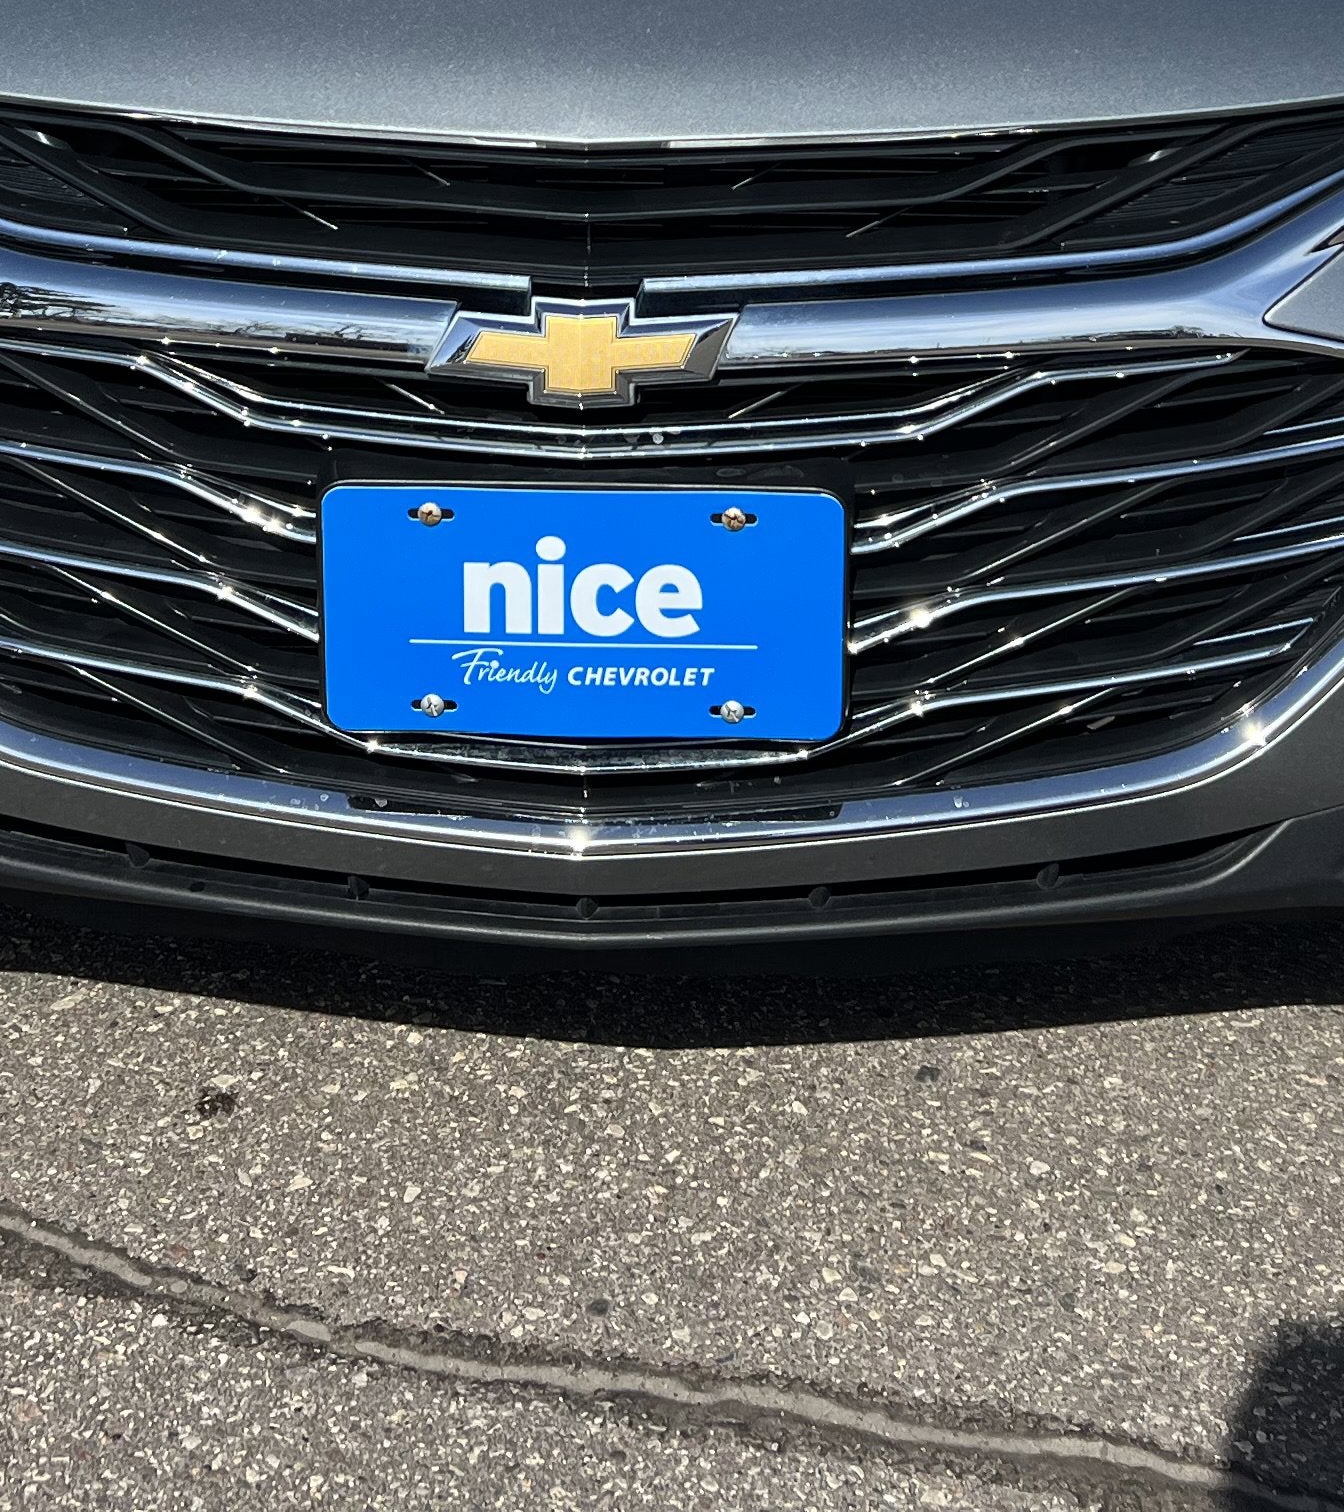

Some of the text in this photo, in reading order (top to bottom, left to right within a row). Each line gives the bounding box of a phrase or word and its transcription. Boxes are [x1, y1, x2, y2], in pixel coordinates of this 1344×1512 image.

[463, 535, 703, 639] nice
[451, 647, 716, 695] Friendly CHEVROLET
